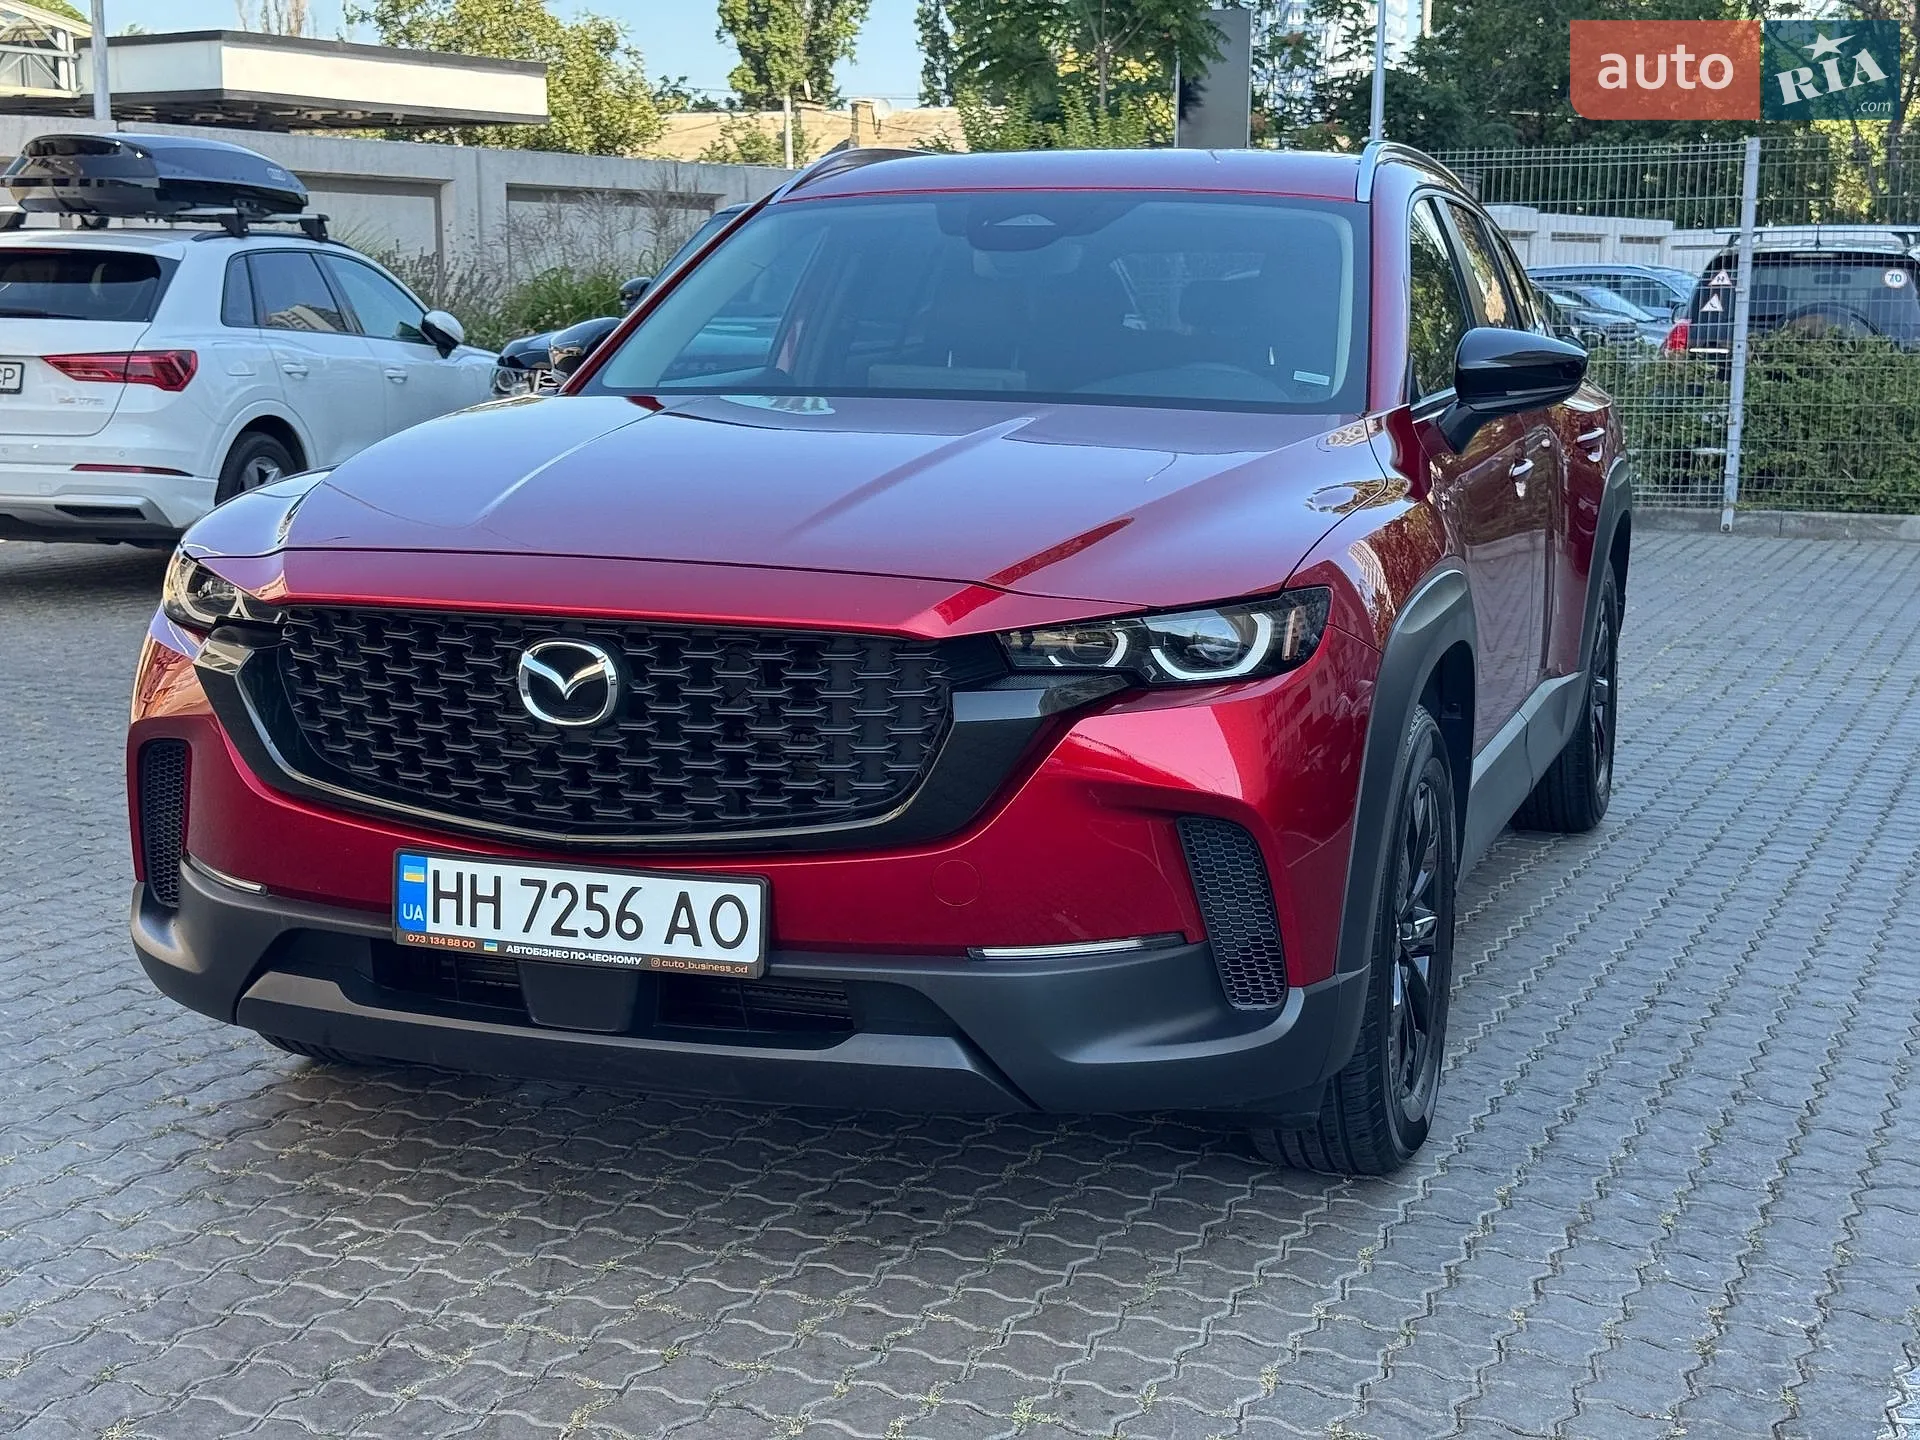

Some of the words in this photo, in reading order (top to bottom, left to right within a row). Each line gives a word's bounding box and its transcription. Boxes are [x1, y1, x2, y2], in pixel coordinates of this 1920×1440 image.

[1887, 273, 1902, 284] 70
[0, 367, 16, 386] P
[402, 903, 425, 922] UA
[432, 869, 502, 930] HH
[520, 878, 644, 941] 7256
[663, 891, 749, 950] AO
[430, 936, 446, 946] 134
[447, 938, 461, 948] 88
[462, 939, 476, 949] 00
[505, 944, 569, 960] АВТОБІЗНЕС
[570, 951, 642, 965] ПО-ЧЕСНОМУ
[661, 959, 748, 974] auto_business_od
